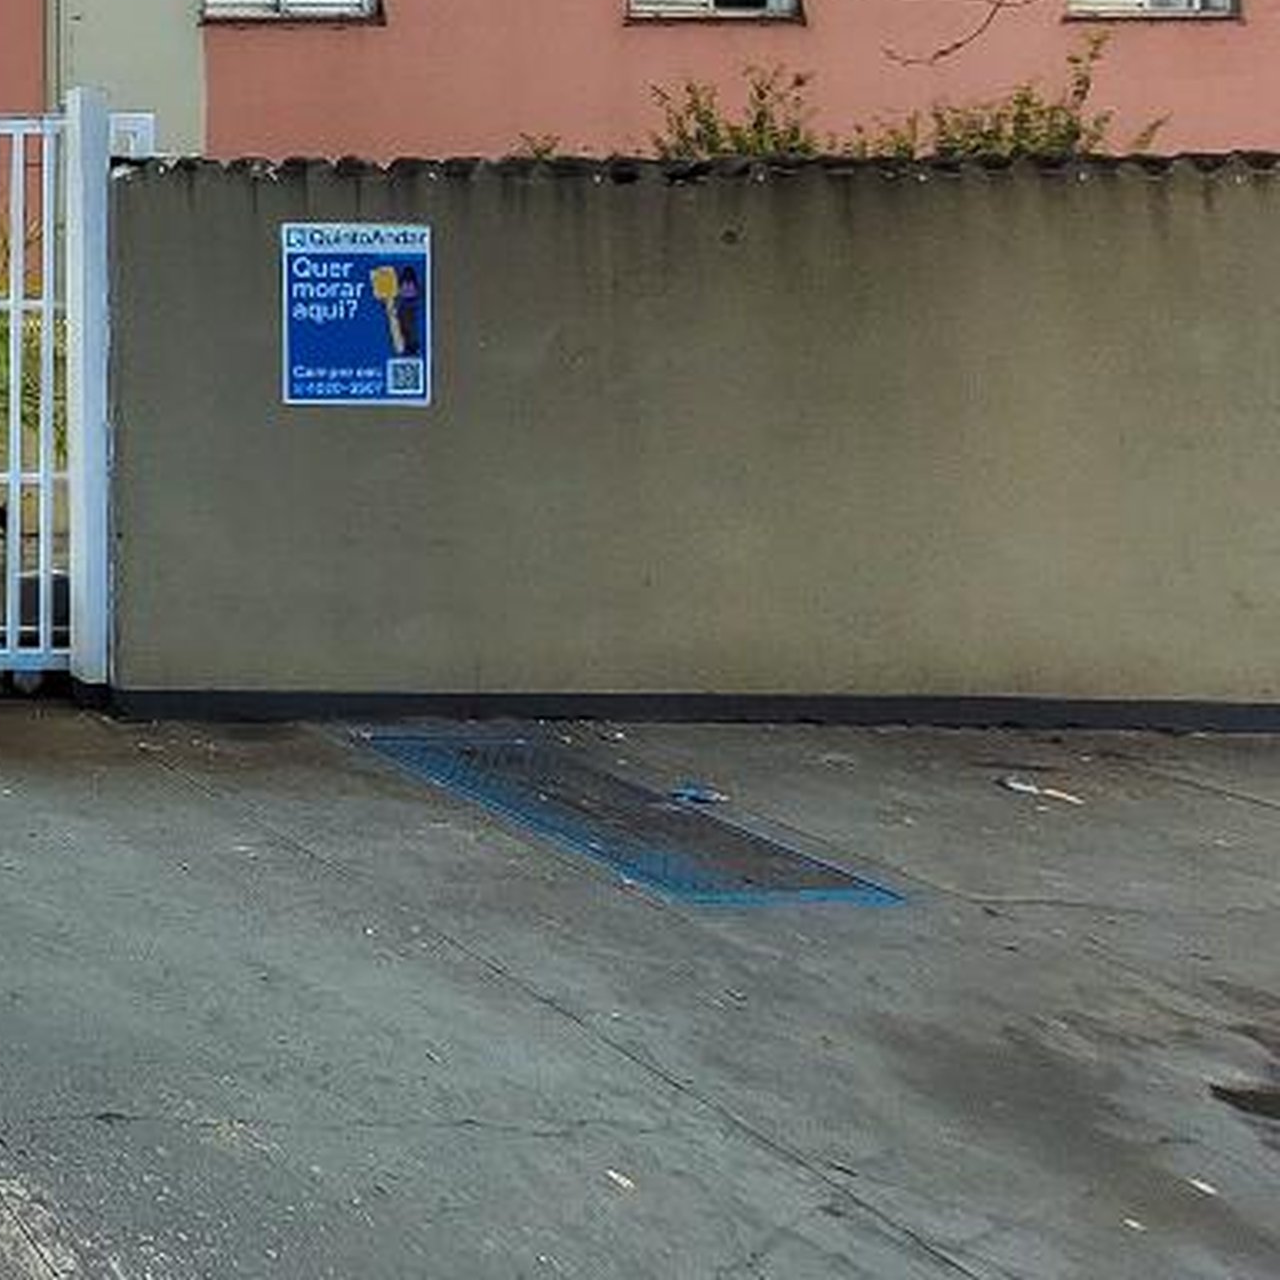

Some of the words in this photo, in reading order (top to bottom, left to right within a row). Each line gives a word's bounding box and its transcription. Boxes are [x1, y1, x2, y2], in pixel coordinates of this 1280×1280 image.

[292, 256, 354, 278] Quer
[292, 282, 365, 298] morar
[292, 300, 358, 323] aqui?
